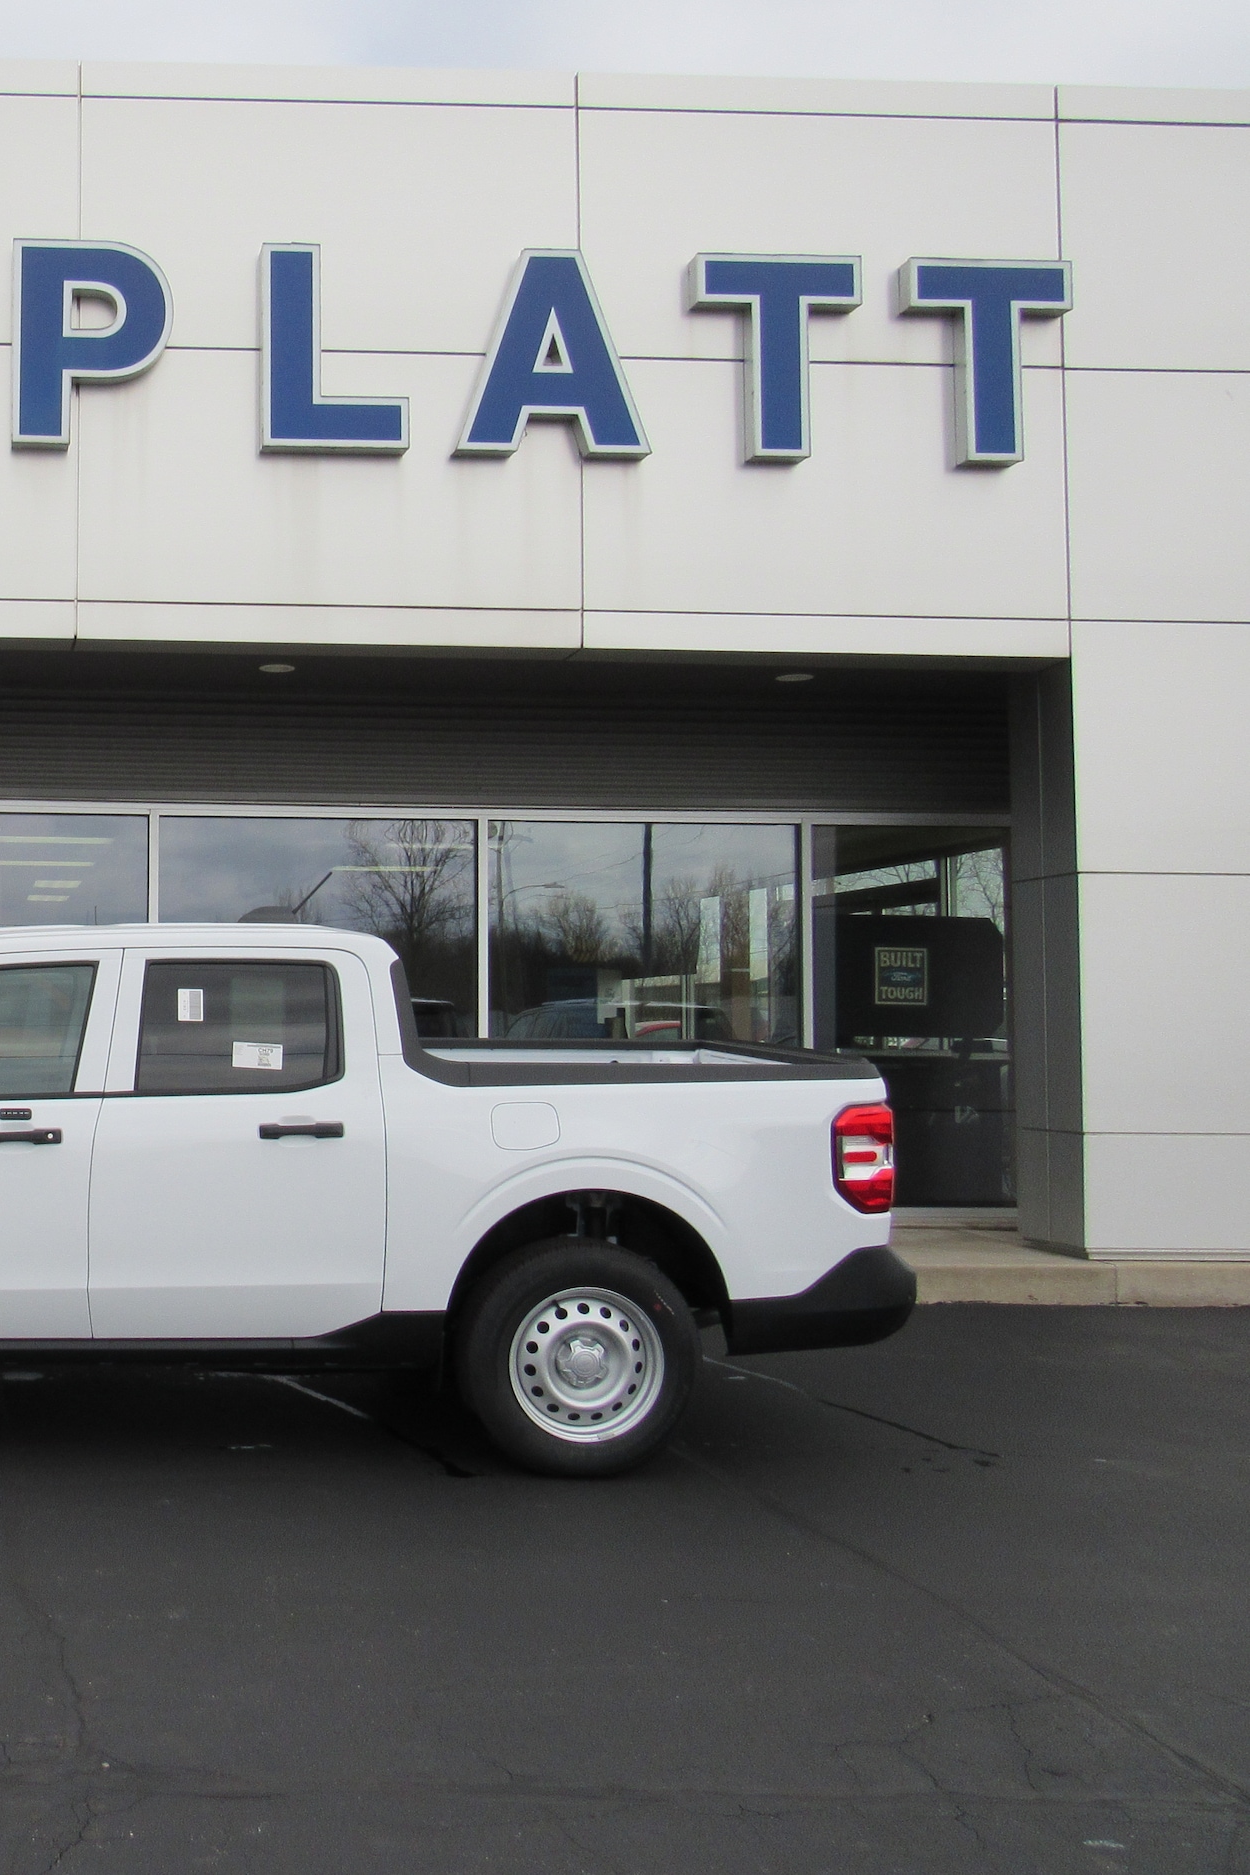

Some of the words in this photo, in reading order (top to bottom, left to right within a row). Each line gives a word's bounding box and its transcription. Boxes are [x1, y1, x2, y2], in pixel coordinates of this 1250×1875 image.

[12, 238, 1073, 467] PLATT
[880, 951, 923, 968] BUILT
[890, 971, 912, 982] Ford
[880, 986, 923, 1000] TOUGH
